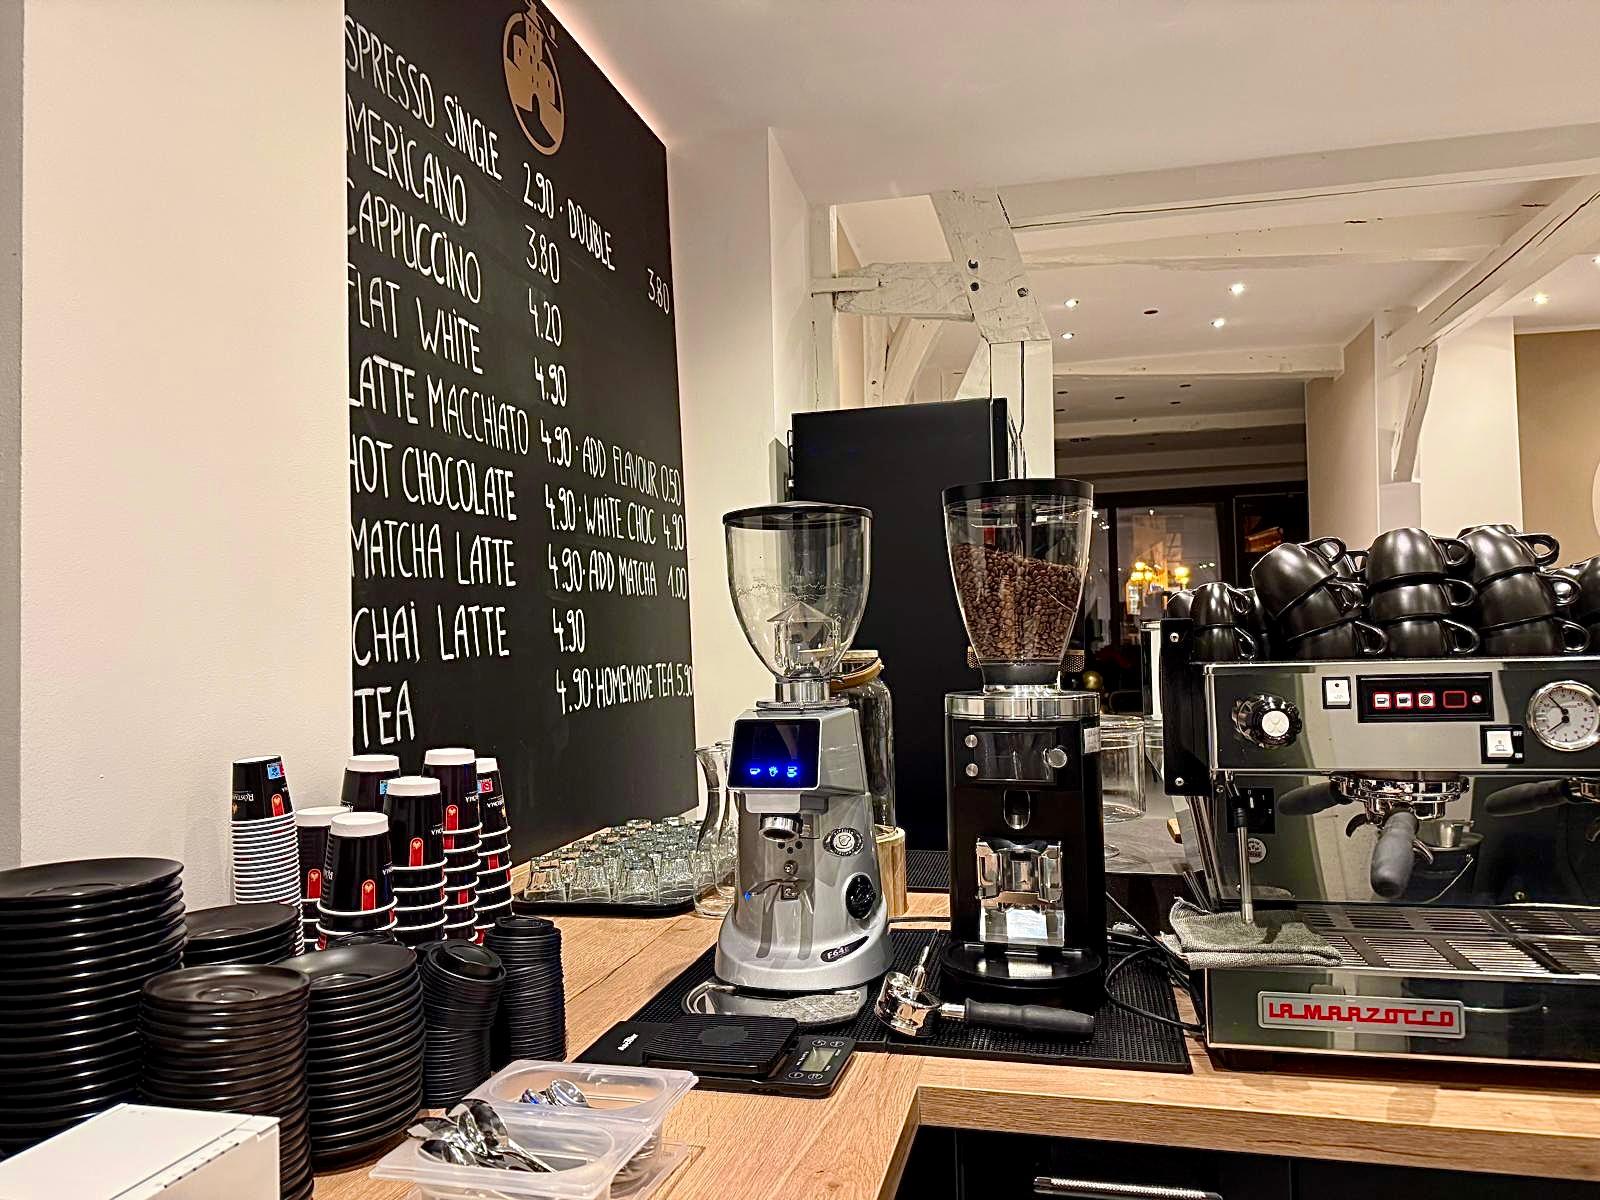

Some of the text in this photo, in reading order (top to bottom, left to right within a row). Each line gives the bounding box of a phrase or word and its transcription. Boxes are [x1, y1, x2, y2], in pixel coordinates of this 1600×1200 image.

[344, 14, 435, 129] SPRESSO
[523, 162, 555, 219] 2.90
[567, 198, 616, 271] DOUBLE
[647, 268, 670, 315] 3.80
[346, 93, 560, 284] MERiCANO 3.80
[528, 287, 562, 347] 4.20
[534, 356, 567, 408] 4.90
[401, 446, 517, 521] CHOCOLATE
[544, 484, 576, 531] 4.90
[627, 502, 657, 545] CHOC
[662, 513, 684, 552] 4.90
[540, 419, 572, 468] 4.90
[582, 435, 607, 479] ADD
[612, 445, 659, 500] FLAVOUR
[660, 464, 682, 507] 0.50
[350, 518, 687, 600] MATCHA LATTE 4.90 ADD MATCHA 1.00
[437, 604, 510, 661] LATTE
[552, 608, 586, 653] 4.90
[354, 661, 693, 749] TEA 4.90 HOMEMADE TEA 5.90
[1269, 1002, 1454, 1027] LA MARZOCCO
